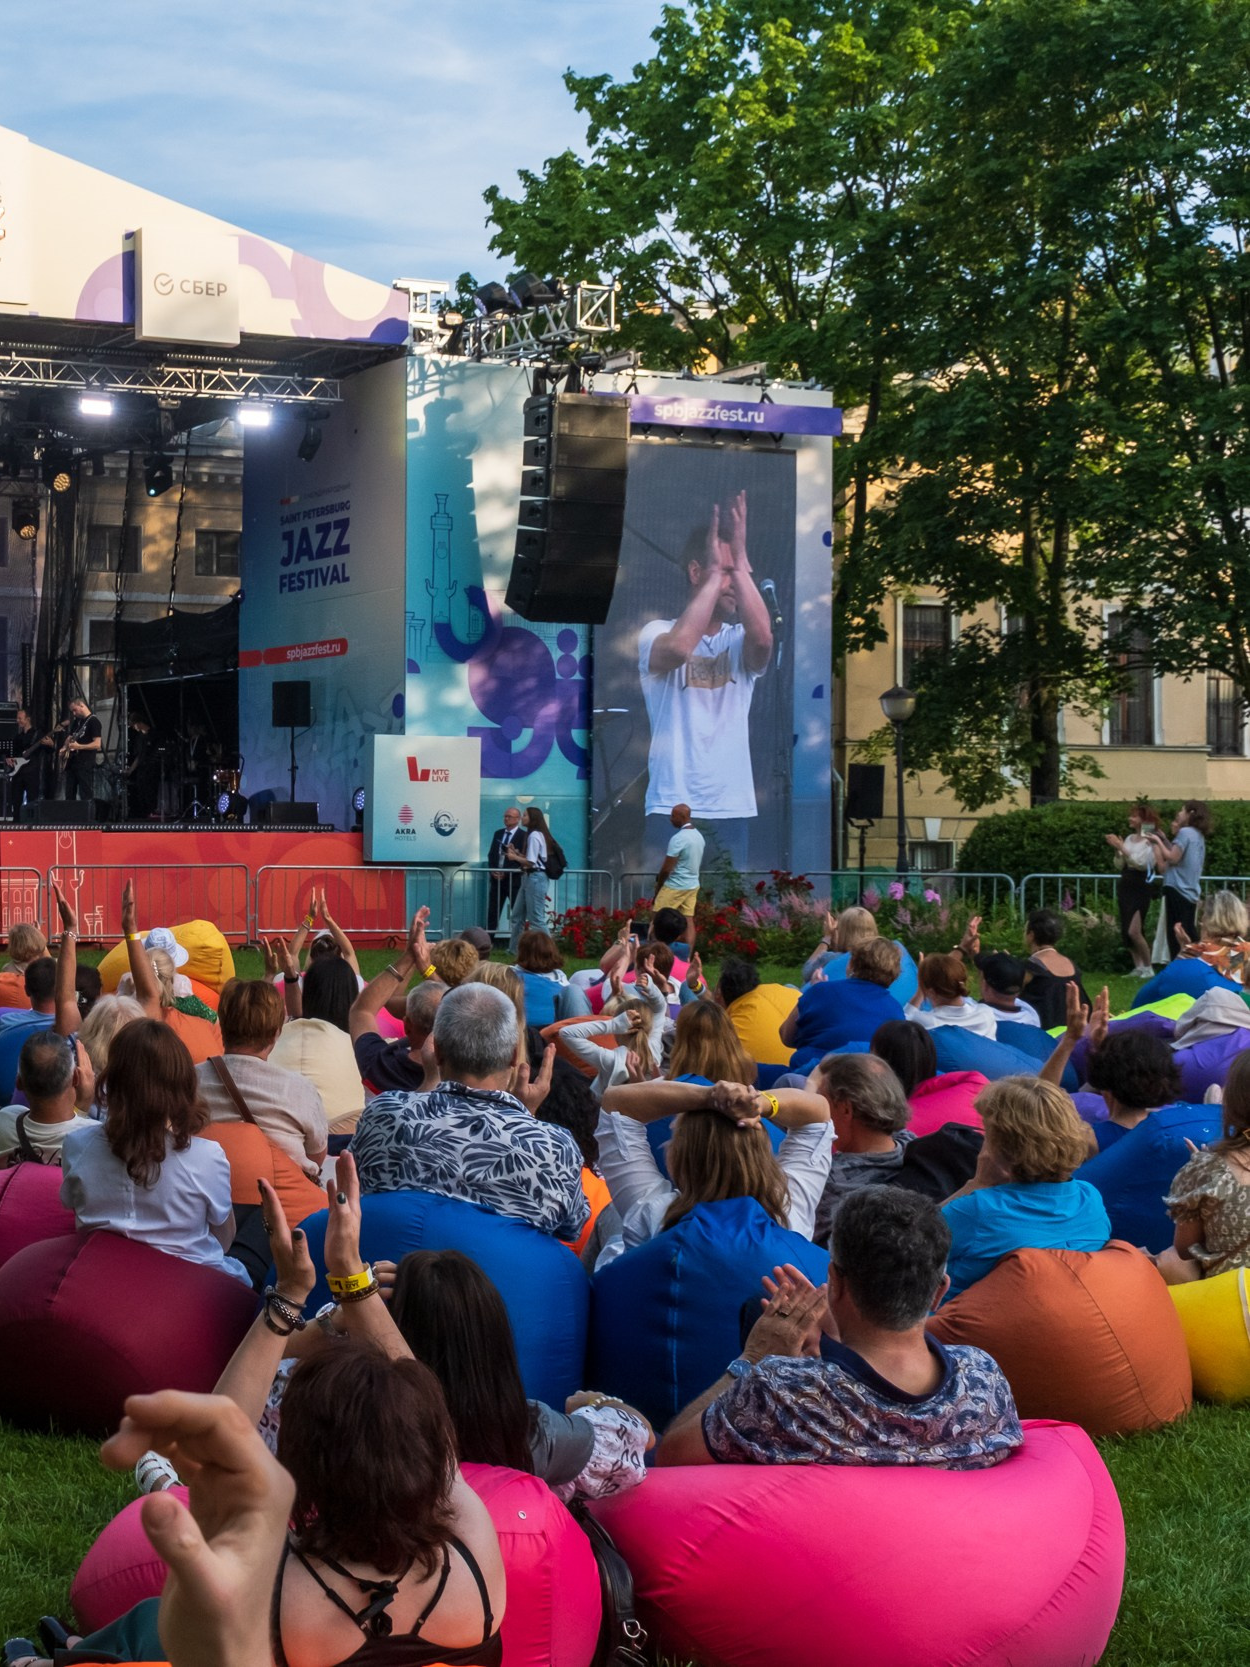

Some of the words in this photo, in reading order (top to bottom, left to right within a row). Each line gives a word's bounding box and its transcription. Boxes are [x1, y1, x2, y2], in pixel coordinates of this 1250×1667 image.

[179, 279, 228, 297] СБЕР
[653, 404, 765, 424] spbjazzfest.ru
[280, 511, 301, 526] SAINT
[302, 500, 351, 520] PETERSBURG
[280, 518, 350, 567] JAZZ
[279, 563, 350, 594] FESTIVAL
[286, 643, 340, 660] spbjazzfest.ru
